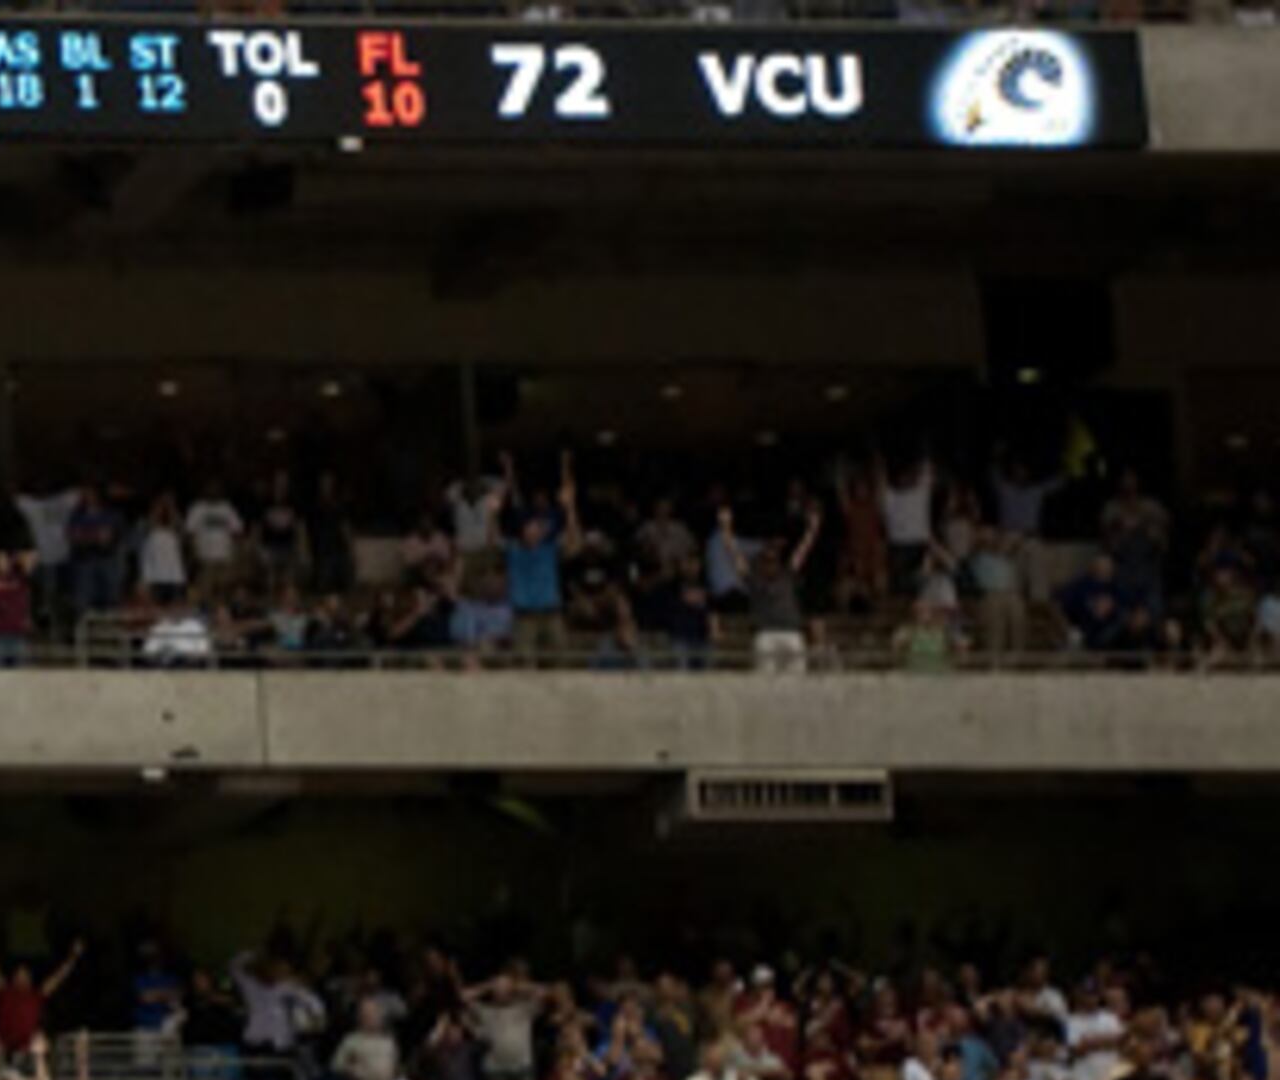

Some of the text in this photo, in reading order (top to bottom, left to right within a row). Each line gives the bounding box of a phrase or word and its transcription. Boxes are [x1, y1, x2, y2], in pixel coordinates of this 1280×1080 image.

[59, 33, 111, 70] BL
[129, 35, 179, 70] ST
[208, 30, 319, 77] TOL
[358, 32, 421, 77] FL
[75, 73, 98, 109] 1
[138, 73, 185, 111] 12
[253, 81, 287, 125] 0
[362, 80, 425, 126] 10
[491, 44, 610, 117] 72
[698, 54, 863, 116] VCU
